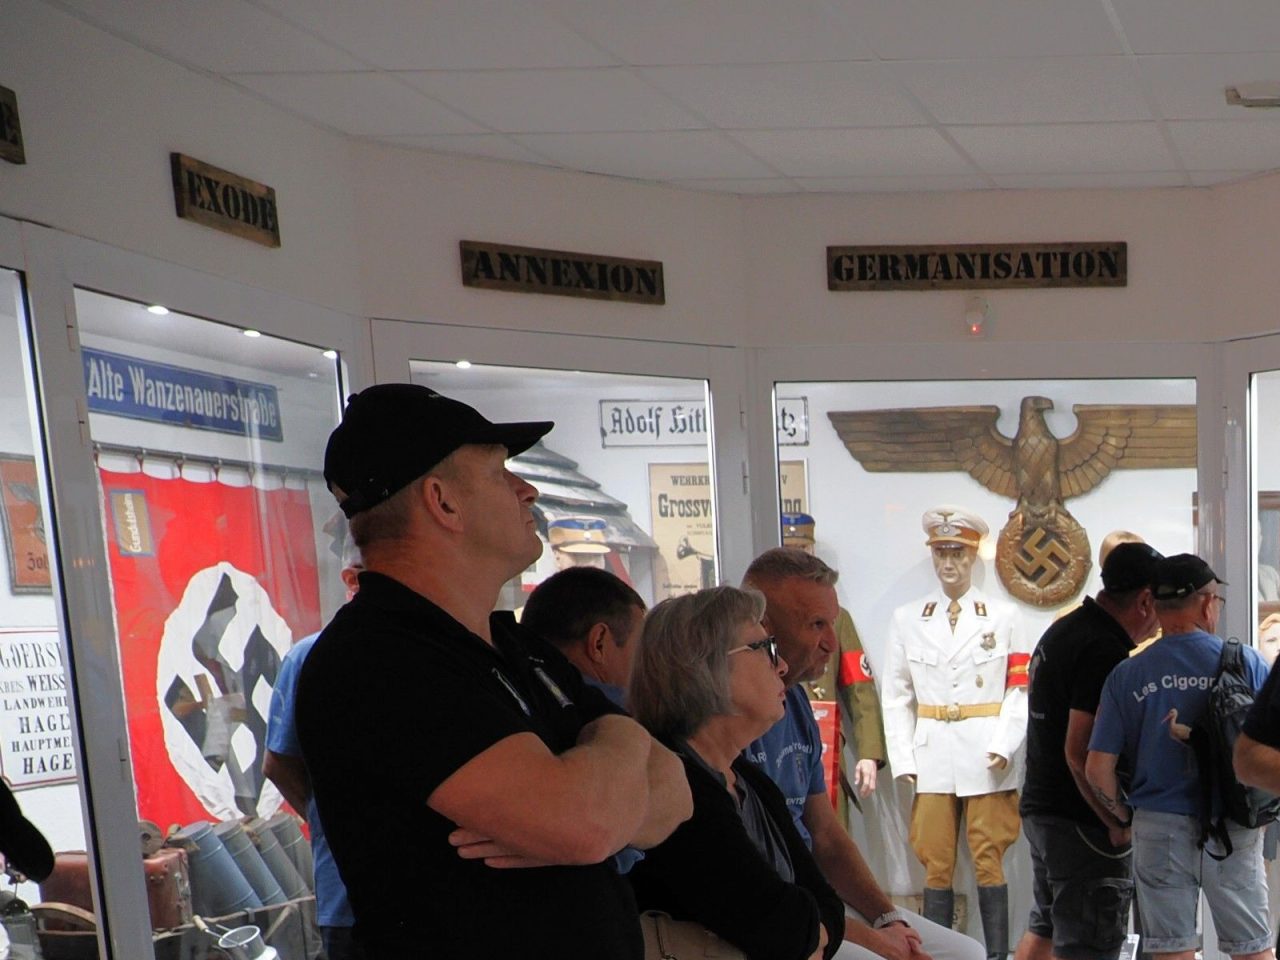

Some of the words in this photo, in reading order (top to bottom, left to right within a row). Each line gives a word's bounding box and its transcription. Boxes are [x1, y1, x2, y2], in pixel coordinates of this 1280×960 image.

[186, 169, 276, 233] EXODE
[473, 251, 656, 295] ANNEXION
[832, 250, 1118, 281] GERMANISATION
[88, 357, 124, 401] Alte
[128, 365, 276, 428] Wanzenauerstraße
[609, 407, 662, 440] Adolf
[1133, 682, 1158, 702] Les
